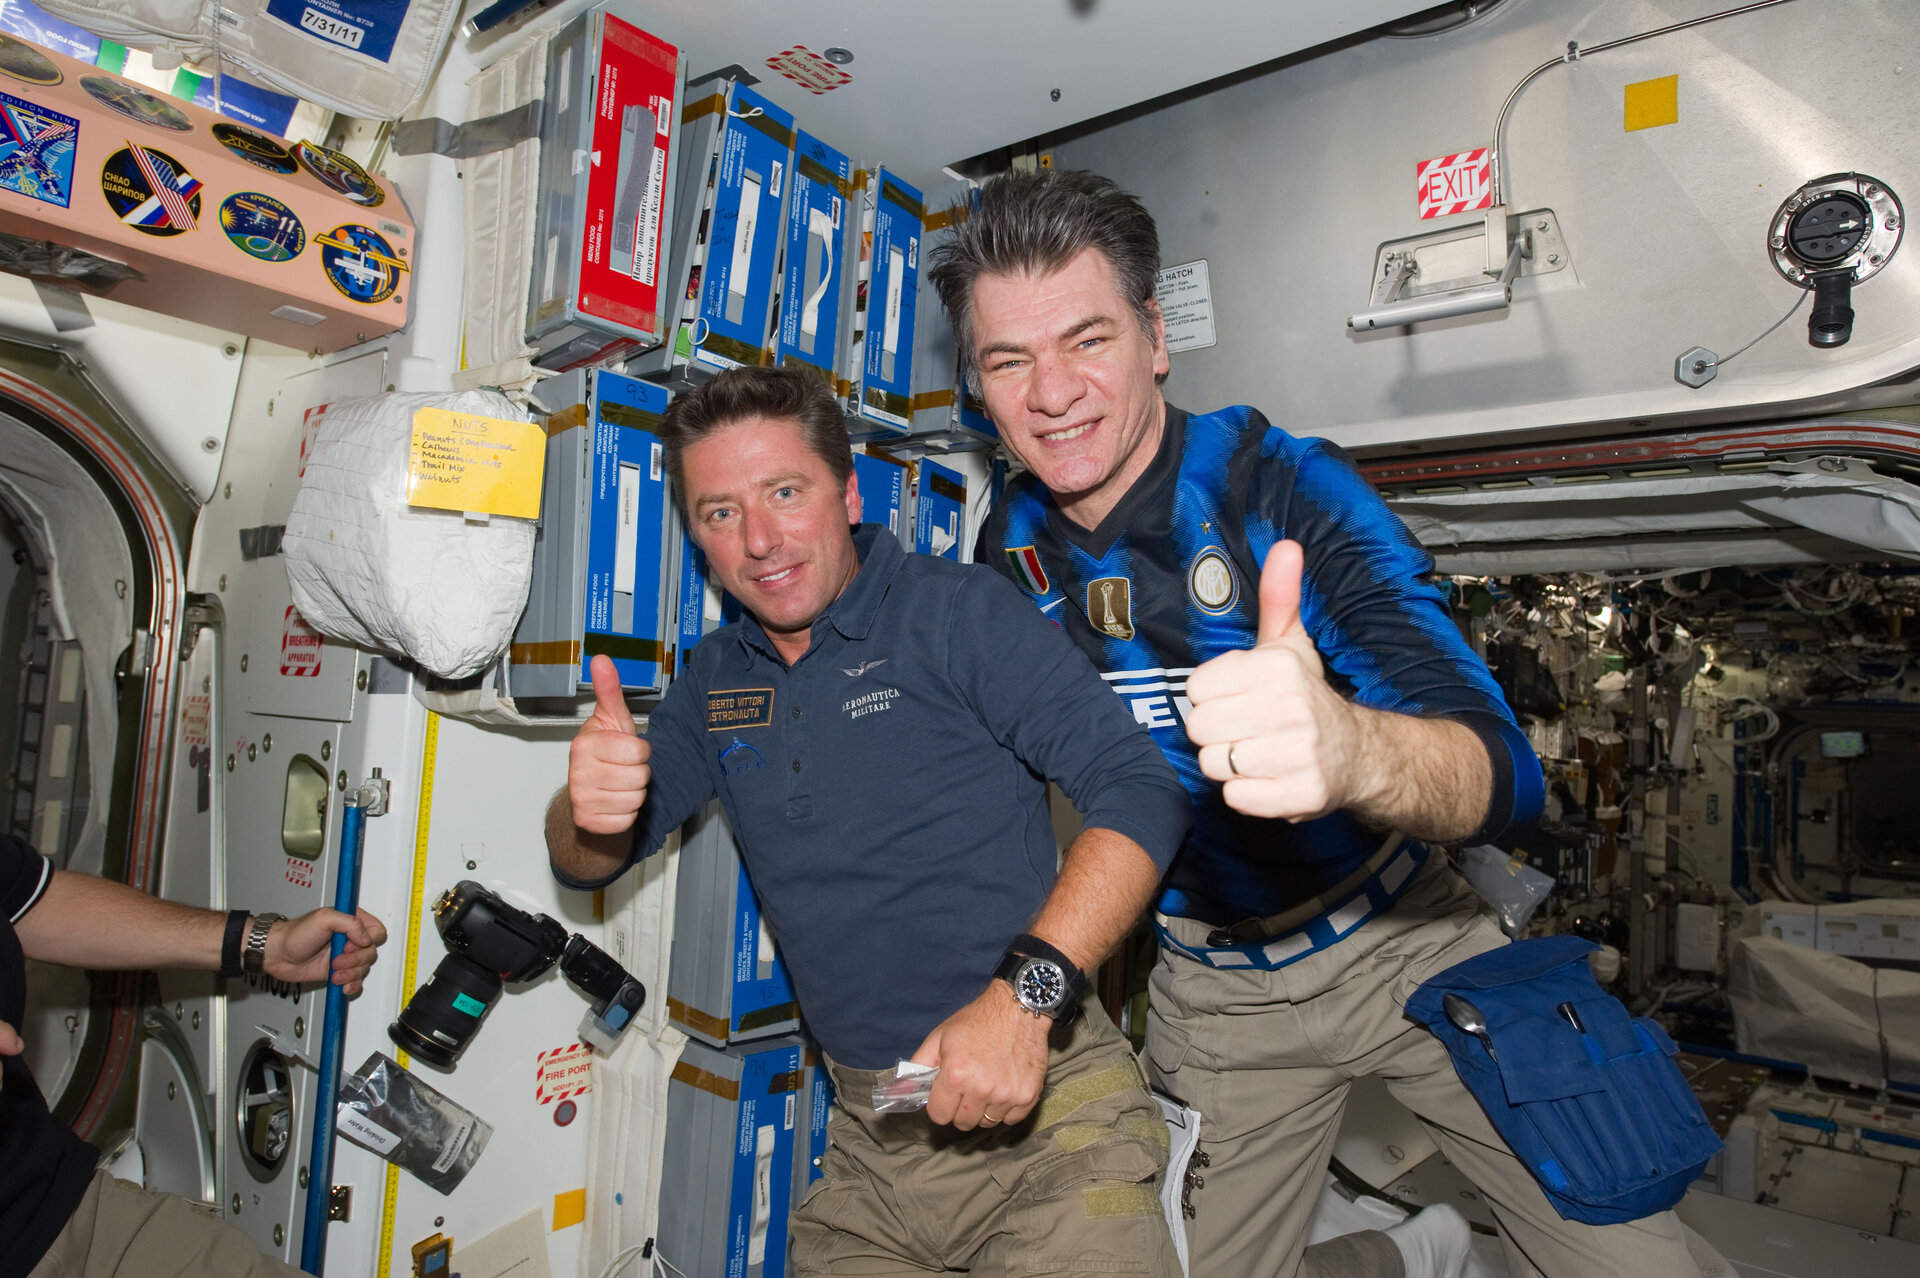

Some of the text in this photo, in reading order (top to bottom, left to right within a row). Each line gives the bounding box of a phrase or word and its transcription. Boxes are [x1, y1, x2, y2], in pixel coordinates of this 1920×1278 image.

[303, 11, 359, 43] 7/31/11
[785, 57, 833, 85] FIRE PORT
[51, 112, 78, 127] NINE
[653, 149, 664, 183] Скотта
[104, 171, 131, 187] CHIAO
[1429, 164, 1478, 203] EXIT
[103, 181, 146, 202] ШАРИПОВ
[650, 184, 661, 213] Келли
[1802, 194, 1821, 207] OPEN
[279, 216, 297, 234] 11
[594, 234, 602, 264] CONTAINER
[632, 250, 644, 280] Набор
[645, 236, 655, 285] продуктов
[1165, 268, 1193, 281] HATCH
[626, 383, 648, 403] 93
[452, 417, 489, 433] NUTS
[421, 441, 460, 454] Cashews
[422, 432, 456, 444] Peanuts
[421, 460, 465, 472] Trail Mix
[419, 472, 462, 484] Walnuts
[891, 471, 900, 505] 3/31/11
[1103, 624, 1124, 632] FIFA
[287, 653, 315, 662] APPARATUS
[737, 695, 765, 708] VITTORI
[842, 687, 900, 713] AERONAUTICA
[851, 701, 891, 720] MILITARE
[545, 1053, 580, 1066] EMERGENCY
[545, 1062, 592, 1082] FIRE PORT
[347, 1118, 386, 1144] Drinking Water
